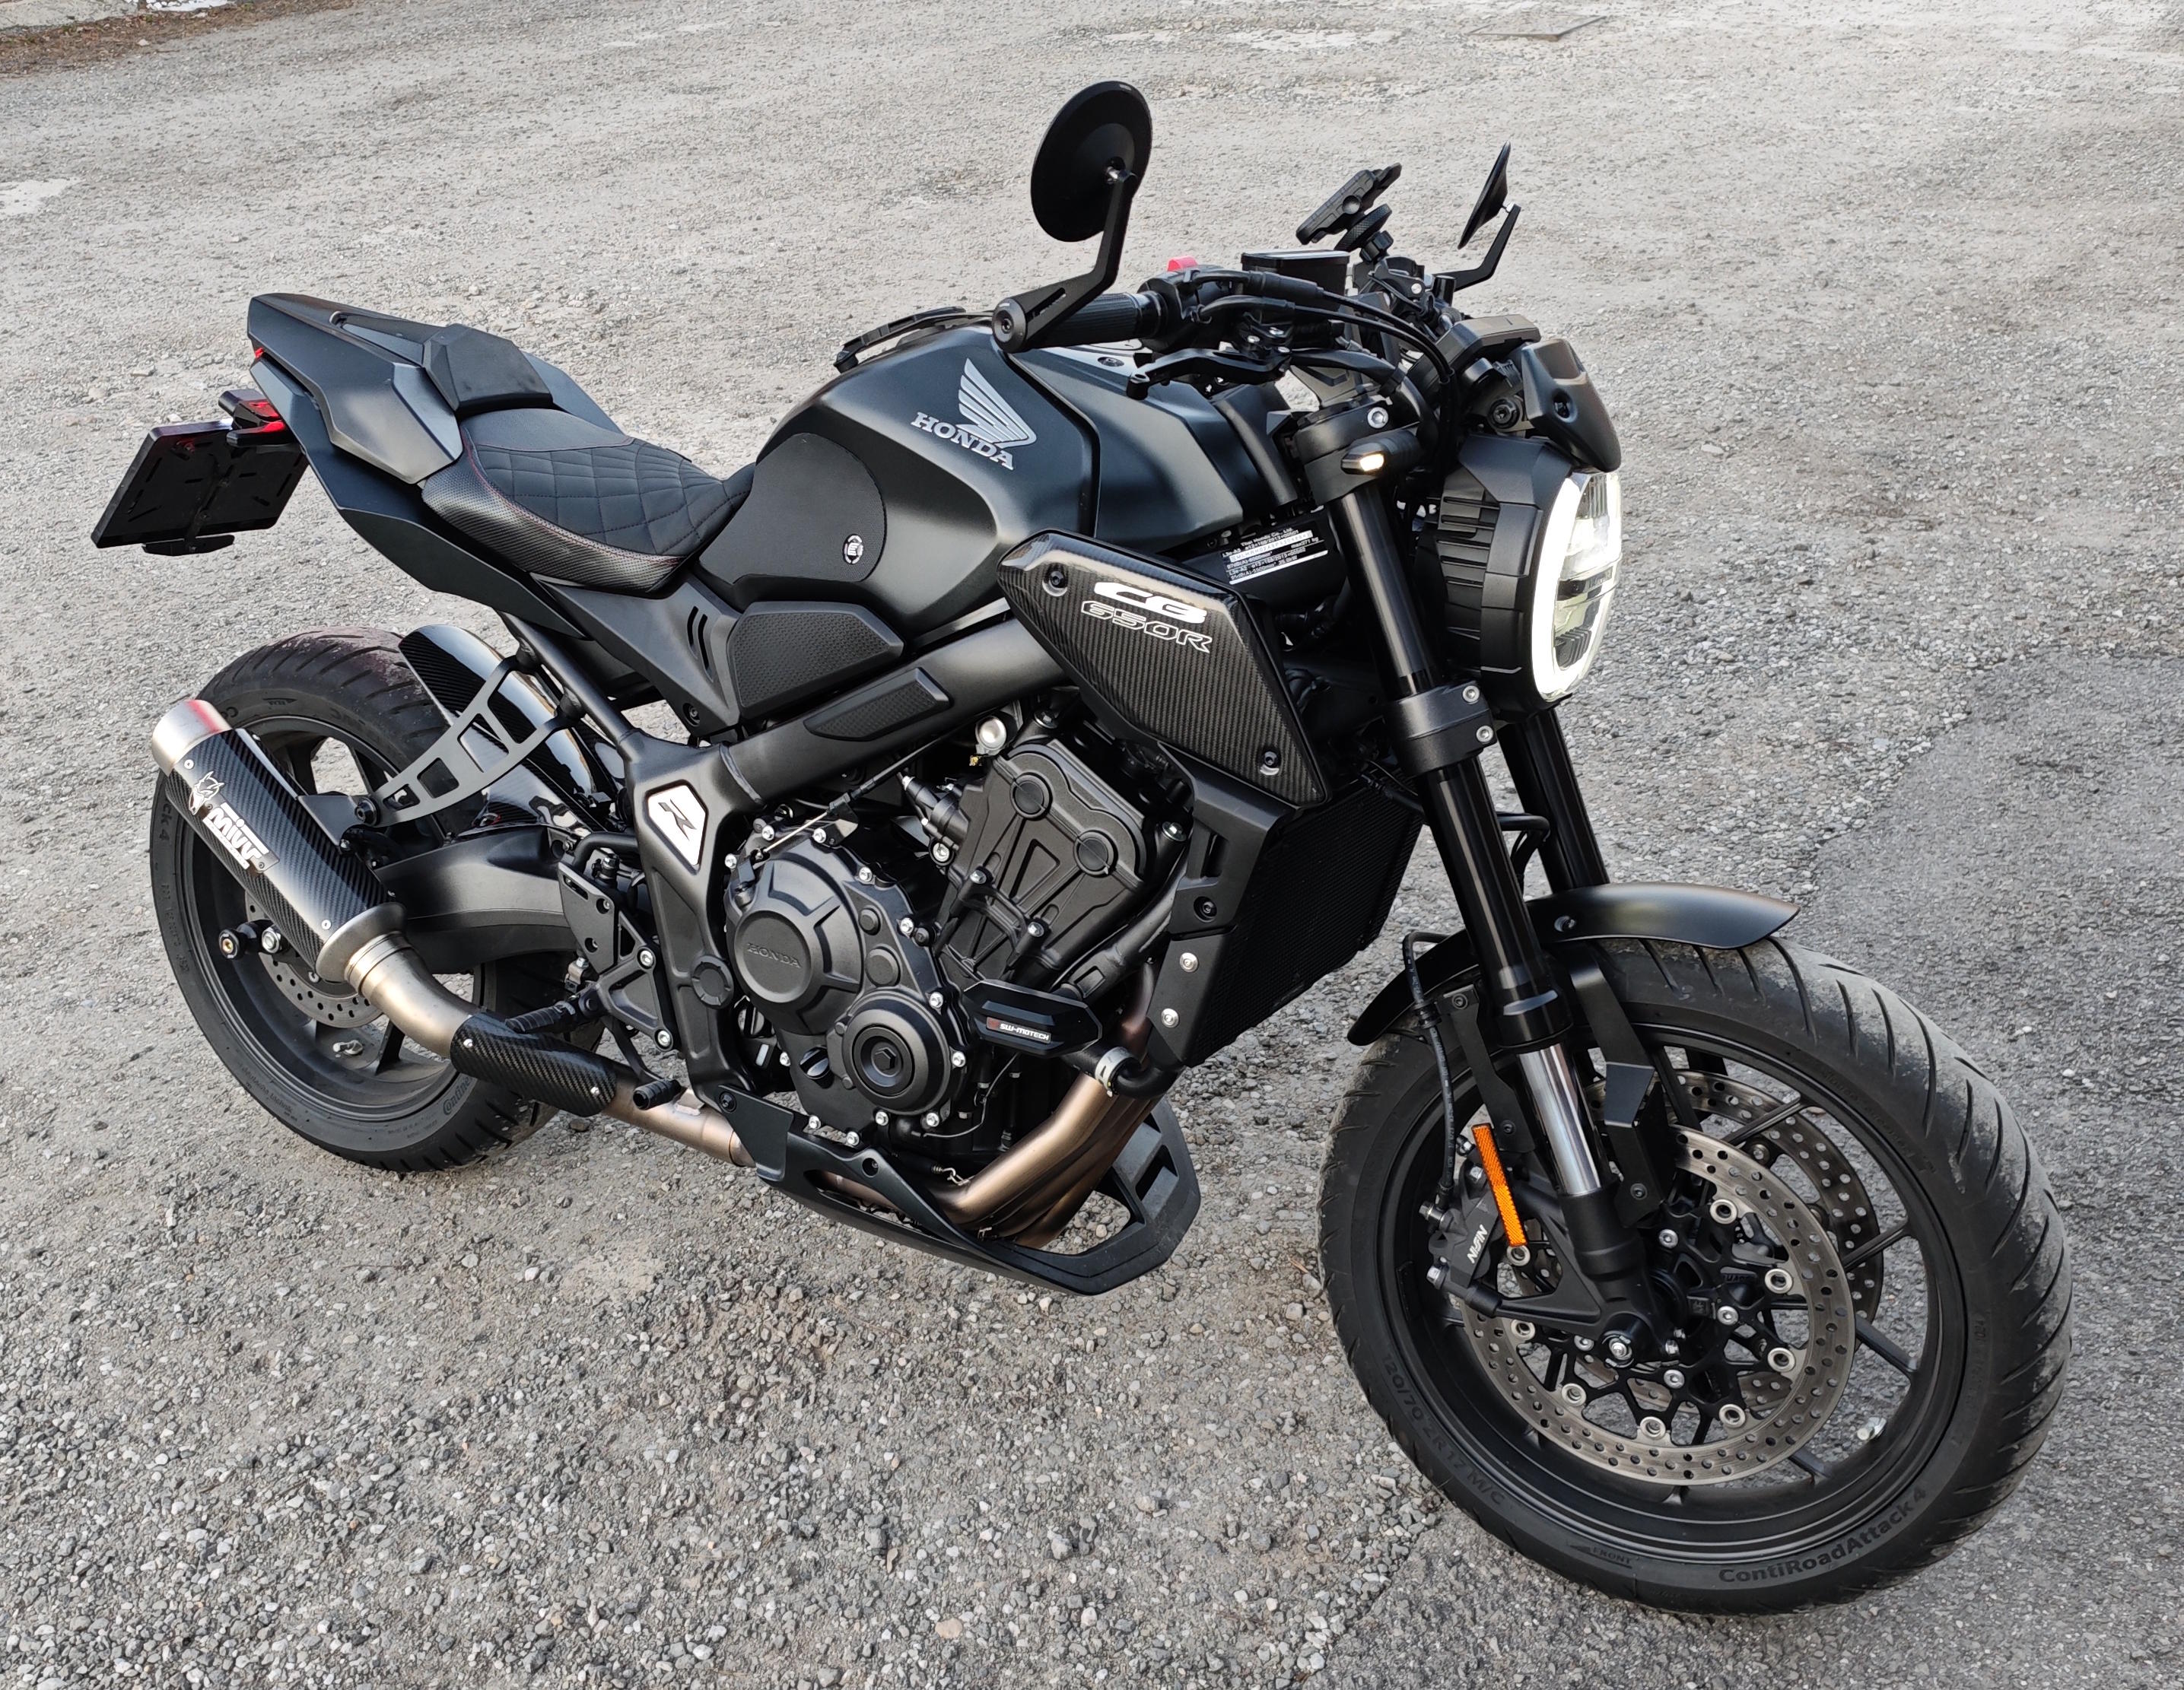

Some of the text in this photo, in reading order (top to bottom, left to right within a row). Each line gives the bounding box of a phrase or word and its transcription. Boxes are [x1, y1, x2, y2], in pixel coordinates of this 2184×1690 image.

[911, 411, 1014, 470] HONDA
[1081, 600, 1213, 653] 650R
[1094, 582, 1207, 624] CB
[747, 943, 801, 969] HONDA
[1000, 1023, 1050, 1040] SW-MOTECH
[443, 1076, 471, 1116] Contine
[1382, 1352, 1425, 1421] 120/70
[1718, 1486, 1927, 1583] ContiRoadAttack 4
